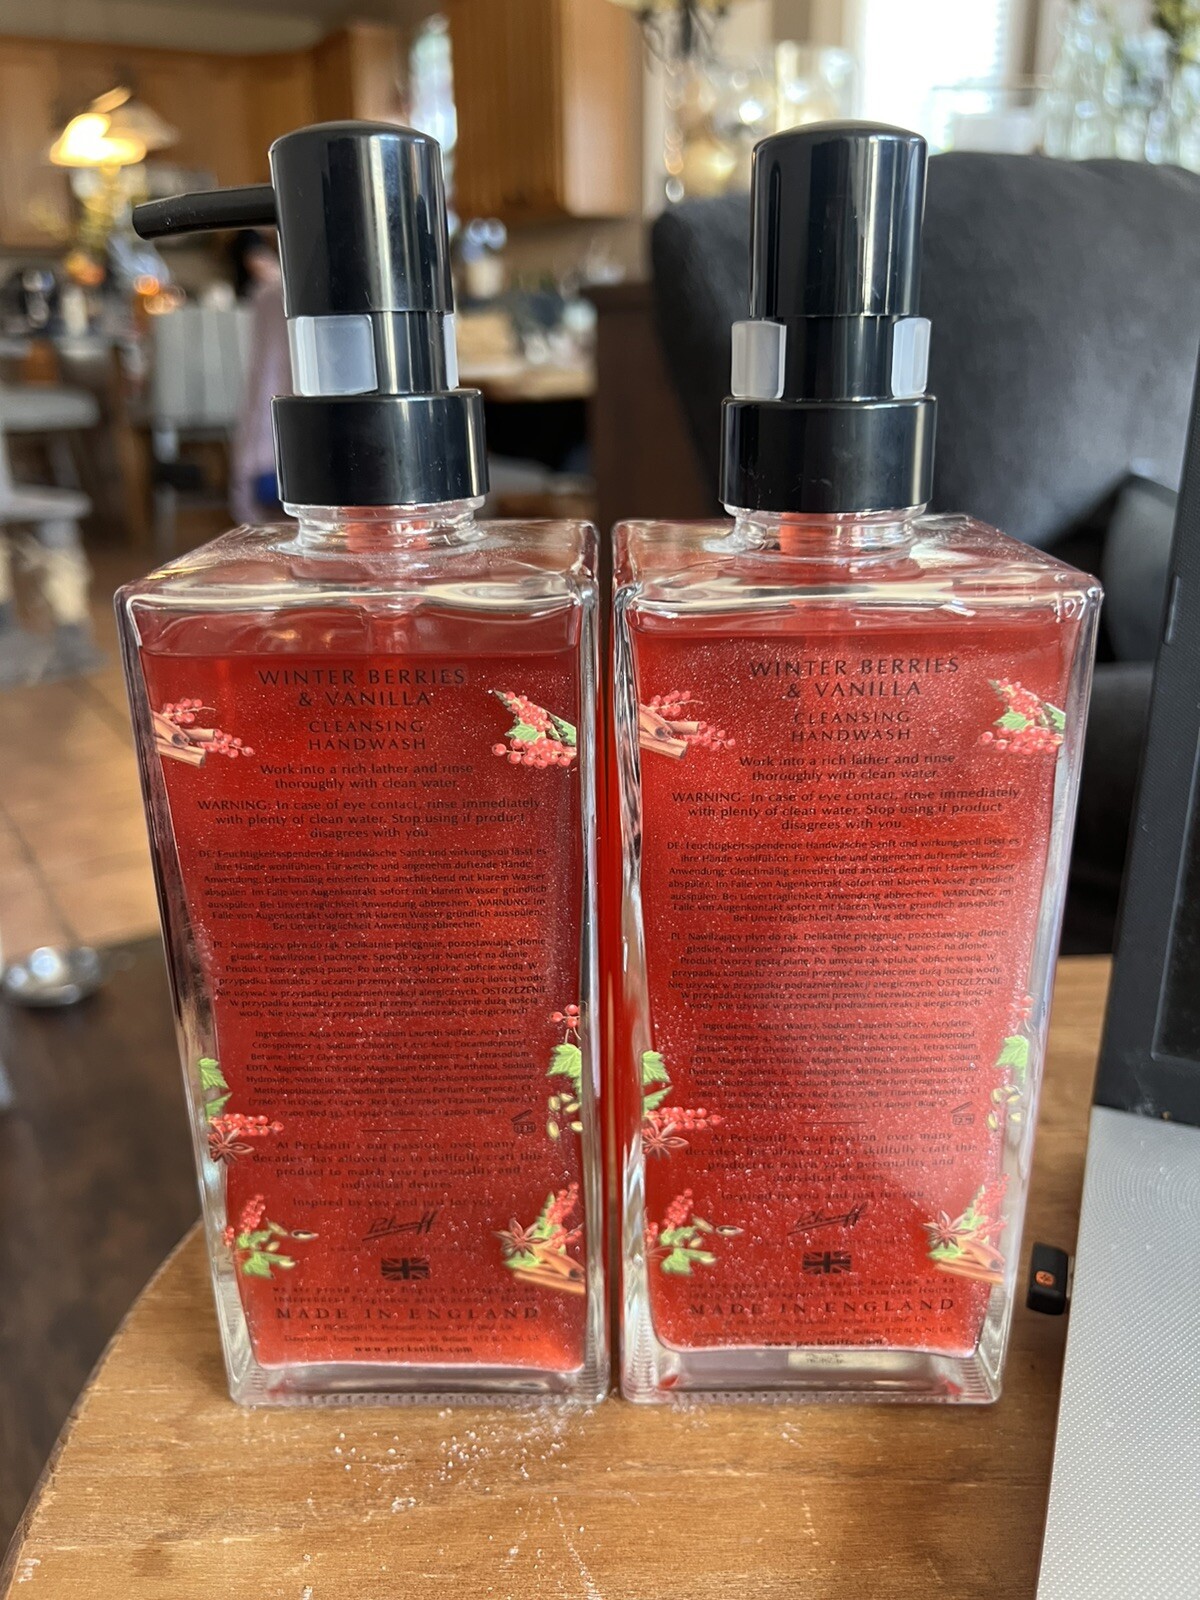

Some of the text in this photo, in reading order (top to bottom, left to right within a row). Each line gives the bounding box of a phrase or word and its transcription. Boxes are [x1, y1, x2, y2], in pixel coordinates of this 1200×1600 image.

[750, 657, 959, 677] WINTER BERRIES
[258, 668, 465, 685] WINTER BERRIES
[787, 681, 921, 698] & VANILLA
[298, 691, 431, 706] & VANILLA
[794, 710, 910, 724] CLEANSING
[308, 720, 424, 733] CLEANSING
[791, 728, 910, 742] HANDWASH
[309, 738, 426, 751] HANDWASH
[739, 756, 774, 767] Work
[779, 756, 804, 766] into
[822, 755, 847, 766] rich
[852, 754, 889, 765] lather
[894, 754, 919, 764] and
[924, 754, 955, 763] rinse
[260, 764, 295, 775] Work
[300, 764, 325, 774] into
[342, 763, 367, 773] rich
[371, 763, 408, 774] lather
[413, 763, 437, 773] and
[442, 763, 473, 772] rinse
[752, 769, 939, 783] thoroughly with clean water.
[275, 778, 459, 791] thoroughly with clean water.
[672, 787, 1020, 804] WARNING: In case of eye contact, rinse immediately
[197, 797, 541, 812] WARNING: In case of eye contact, rinse immediately
[688, 803, 1002, 819] with plenty of clean water. Stop using if product
[215, 813, 524, 827] with plenty of clean water. Stop using if product
[781, 818, 905, 832] disagrees with you.
[310, 828, 432, 840] disagrees with you.
[276, 1307, 538, 1320] MADE IN ENGLAND
[690, 1299, 954, 1315] MADE IN ENGLAND
